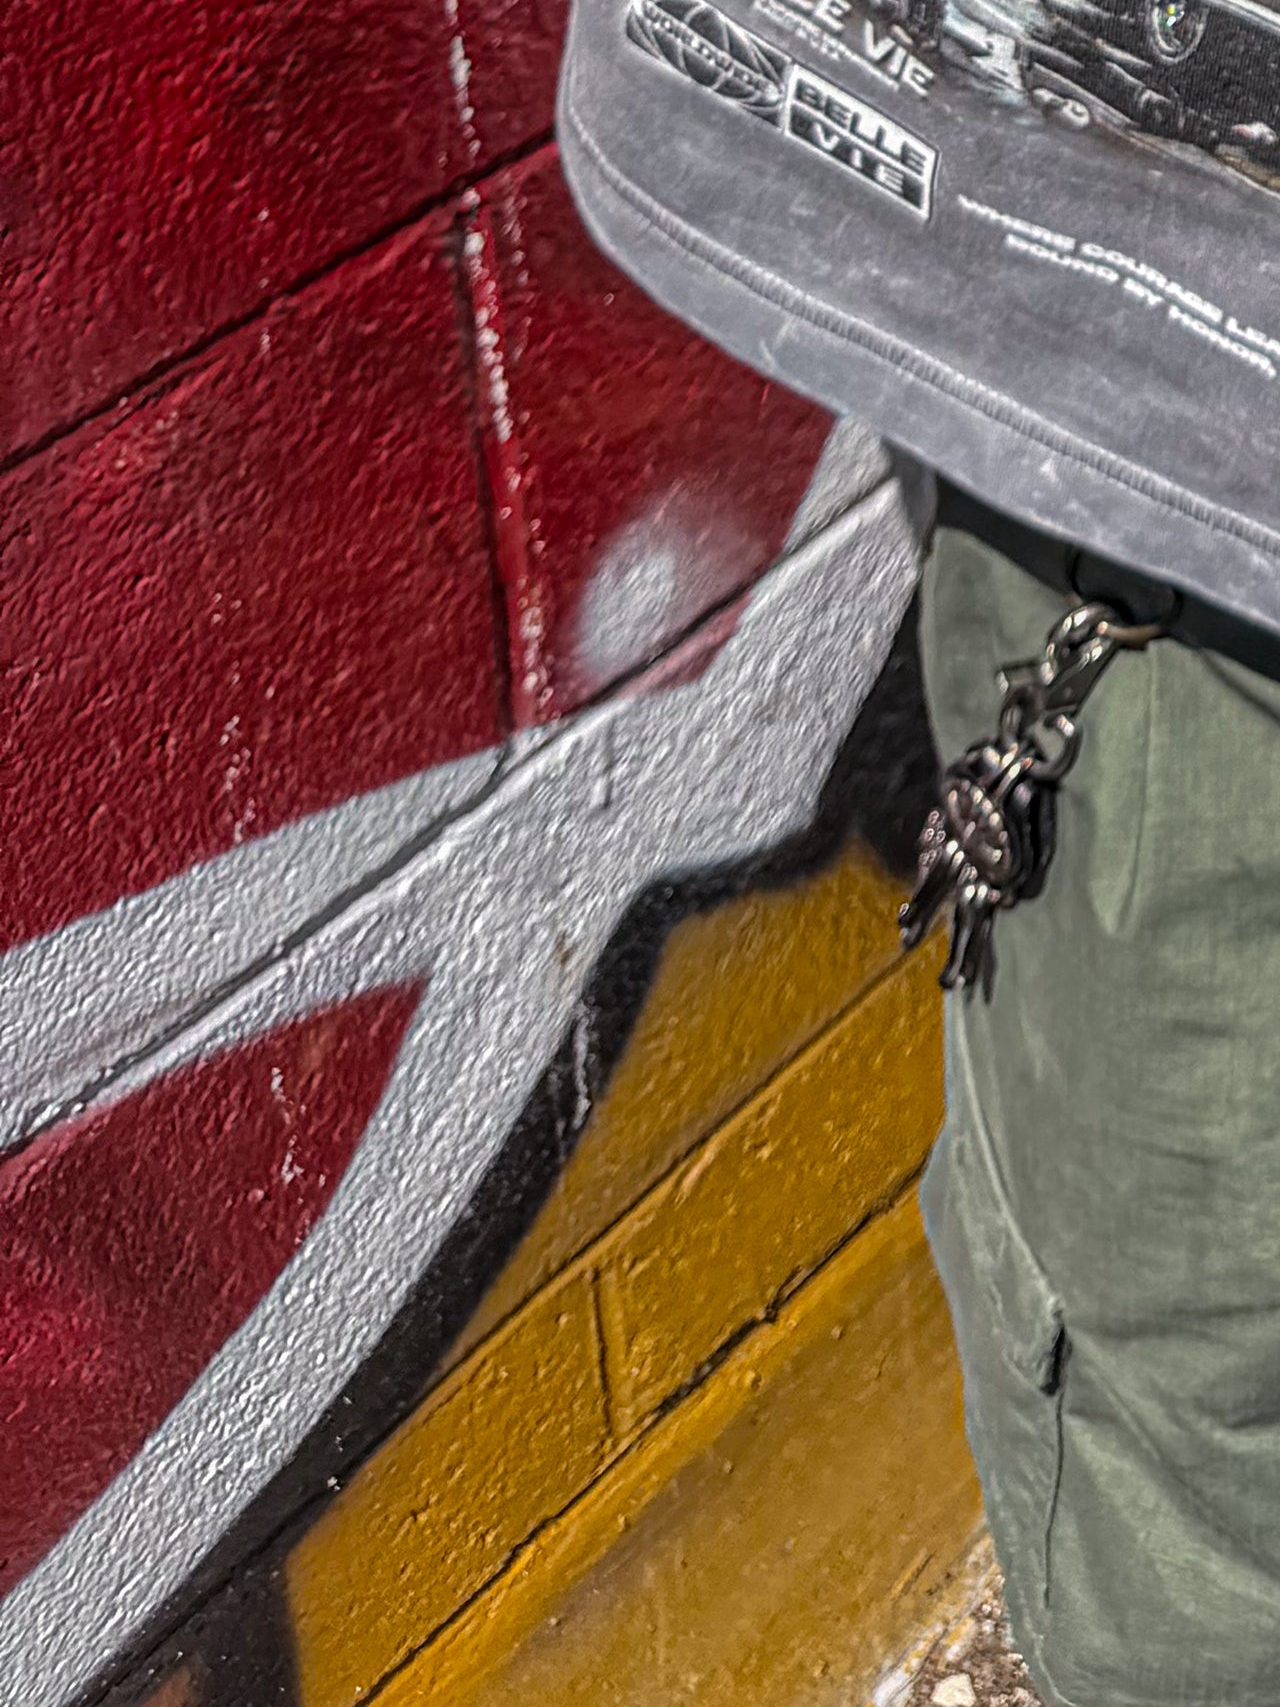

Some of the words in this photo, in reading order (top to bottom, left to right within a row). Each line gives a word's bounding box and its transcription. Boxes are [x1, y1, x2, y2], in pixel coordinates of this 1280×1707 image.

[863, 19, 936, 100] VIE
[794, 76, 928, 177] BELLE
[812, 120, 905, 193] VIE
[958, 194, 1076, 252] WHERE
[1080, 242, 1223, 322] COURAGE
[1005, 233, 1119, 282] BOUND
[1122, 277, 1164, 307] BY
